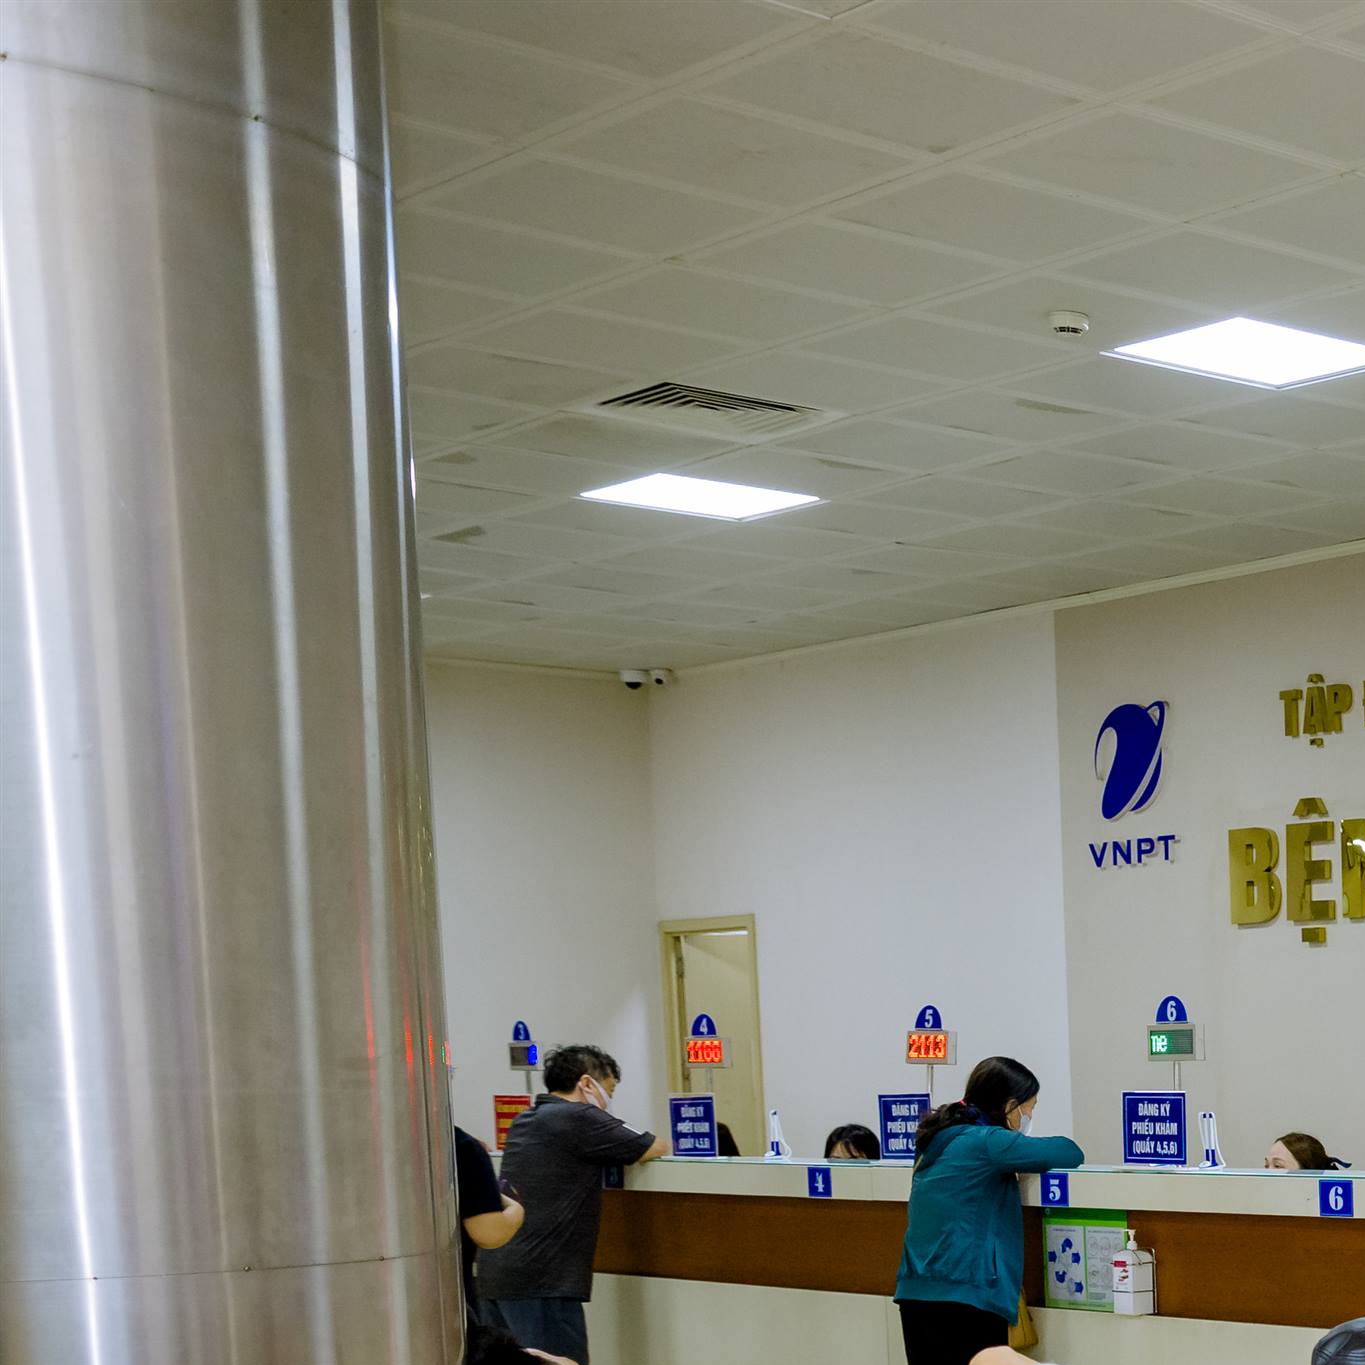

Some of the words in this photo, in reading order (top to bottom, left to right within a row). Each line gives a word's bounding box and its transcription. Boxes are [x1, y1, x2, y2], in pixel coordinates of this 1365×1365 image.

[1280, 674, 1352, 748] TẬP
[1089, 834, 1176, 868] VNPT
[924, 1009, 934, 1028] 5
[1167, 1001, 1177, 1021] 6
[699, 1018, 708, 1034] 4
[909, 1034, 946, 1058] 2113
[1160, 1101, 1170, 1116] KÝ
[814, 1173, 824, 1192] 4
[1049, 1179, 1061, 1200] 5
[1329, 1186, 1344, 1211] 6
